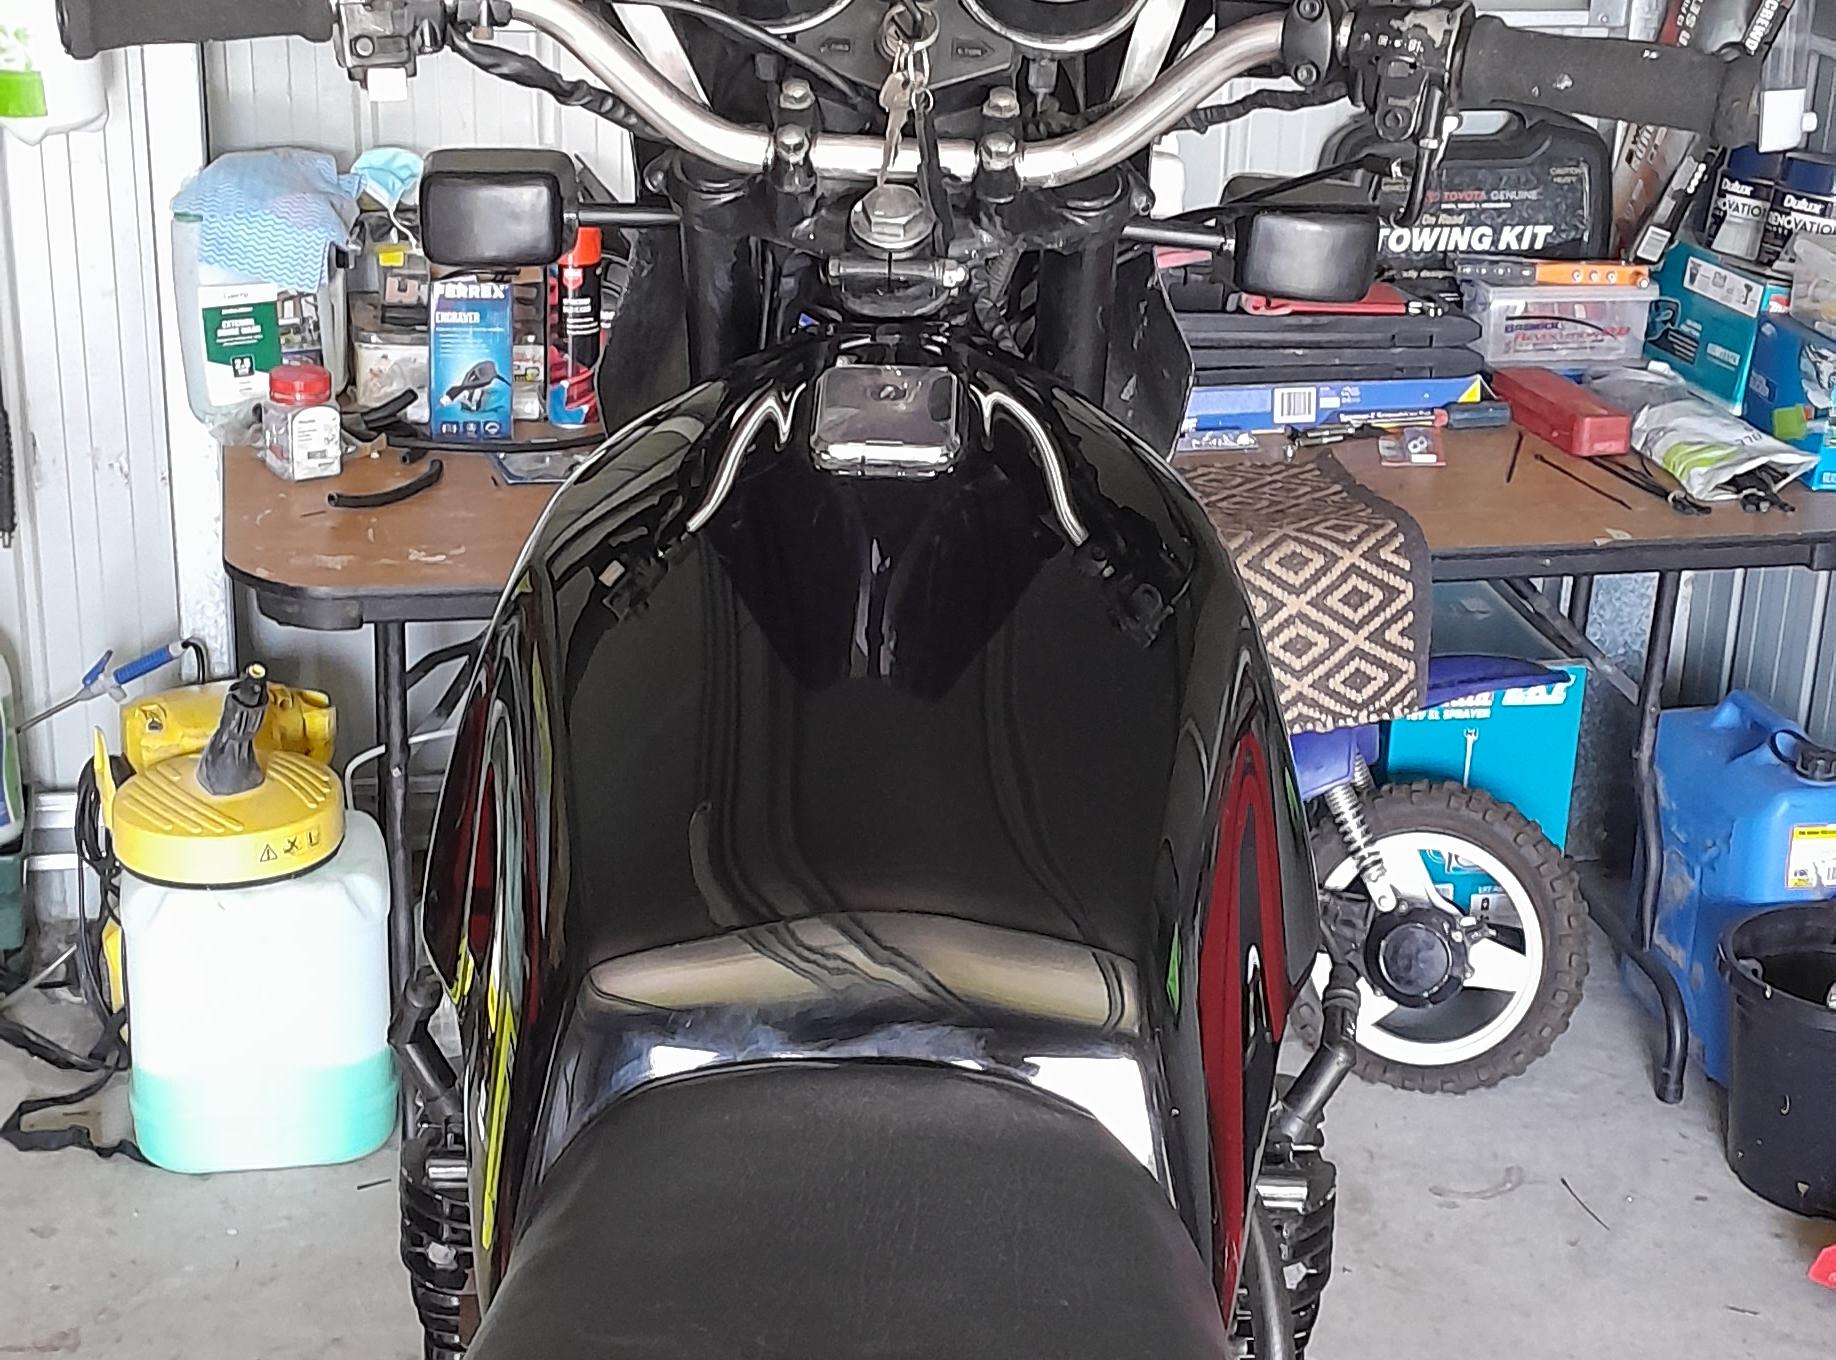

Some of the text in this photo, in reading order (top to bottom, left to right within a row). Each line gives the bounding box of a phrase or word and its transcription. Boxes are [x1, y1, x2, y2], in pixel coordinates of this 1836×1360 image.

[1443, 190, 1487, 200] TOYOTA
[1721, 178, 1753, 195] Dulux
[1783, 194, 1824, 214] Dulux
[1498, 225, 1553, 250] KIT
[435, 311, 481, 323] ENGRAVER
